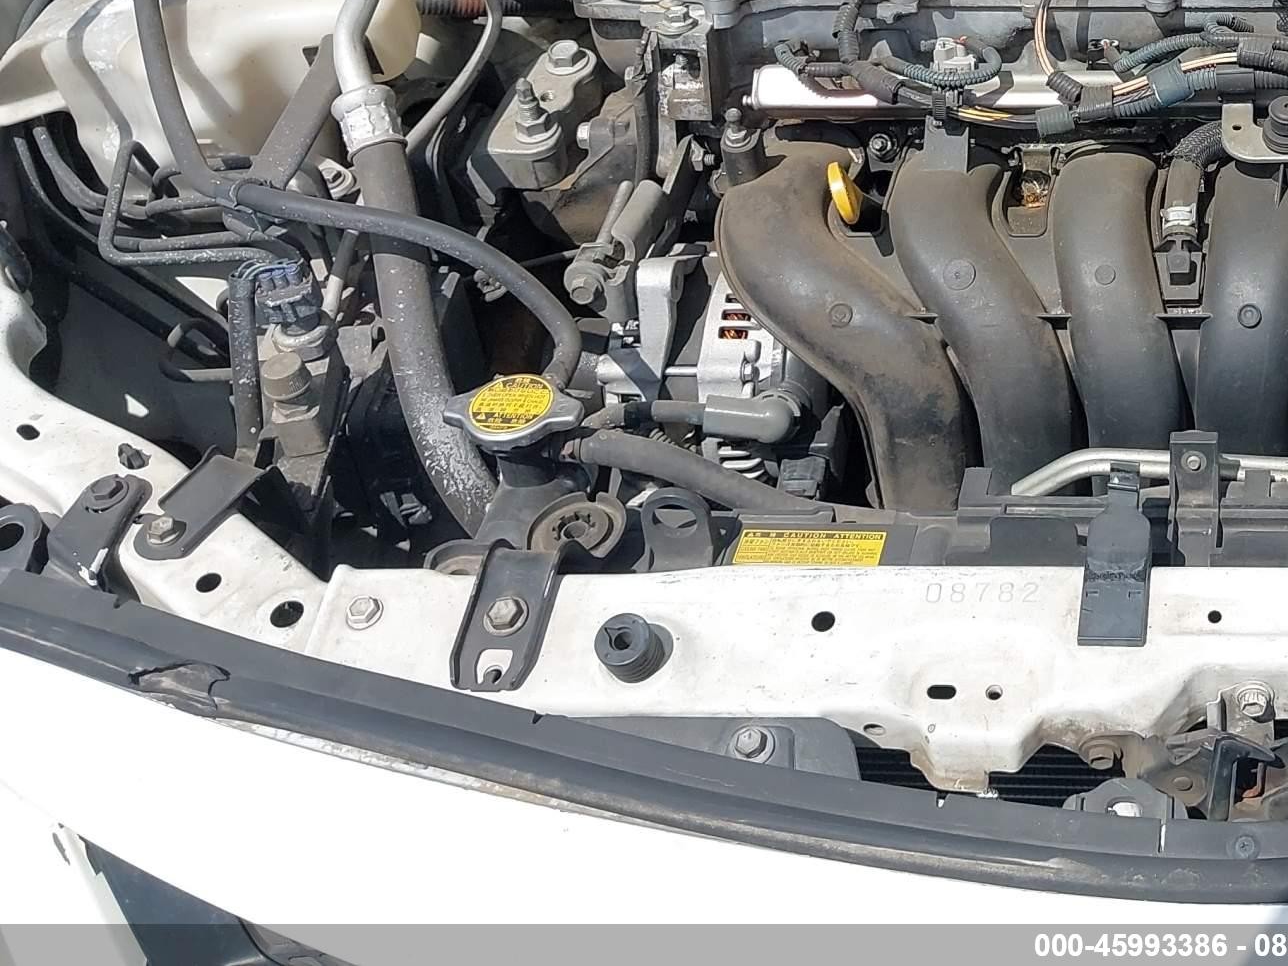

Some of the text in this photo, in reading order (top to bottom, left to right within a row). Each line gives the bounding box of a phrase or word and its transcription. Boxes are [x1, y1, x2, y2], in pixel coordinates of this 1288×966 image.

[493, 412, 534, 420] ATTENTION
[833, 532, 882, 540] ATTENTION
[925, 582, 1040, 603] 08782
